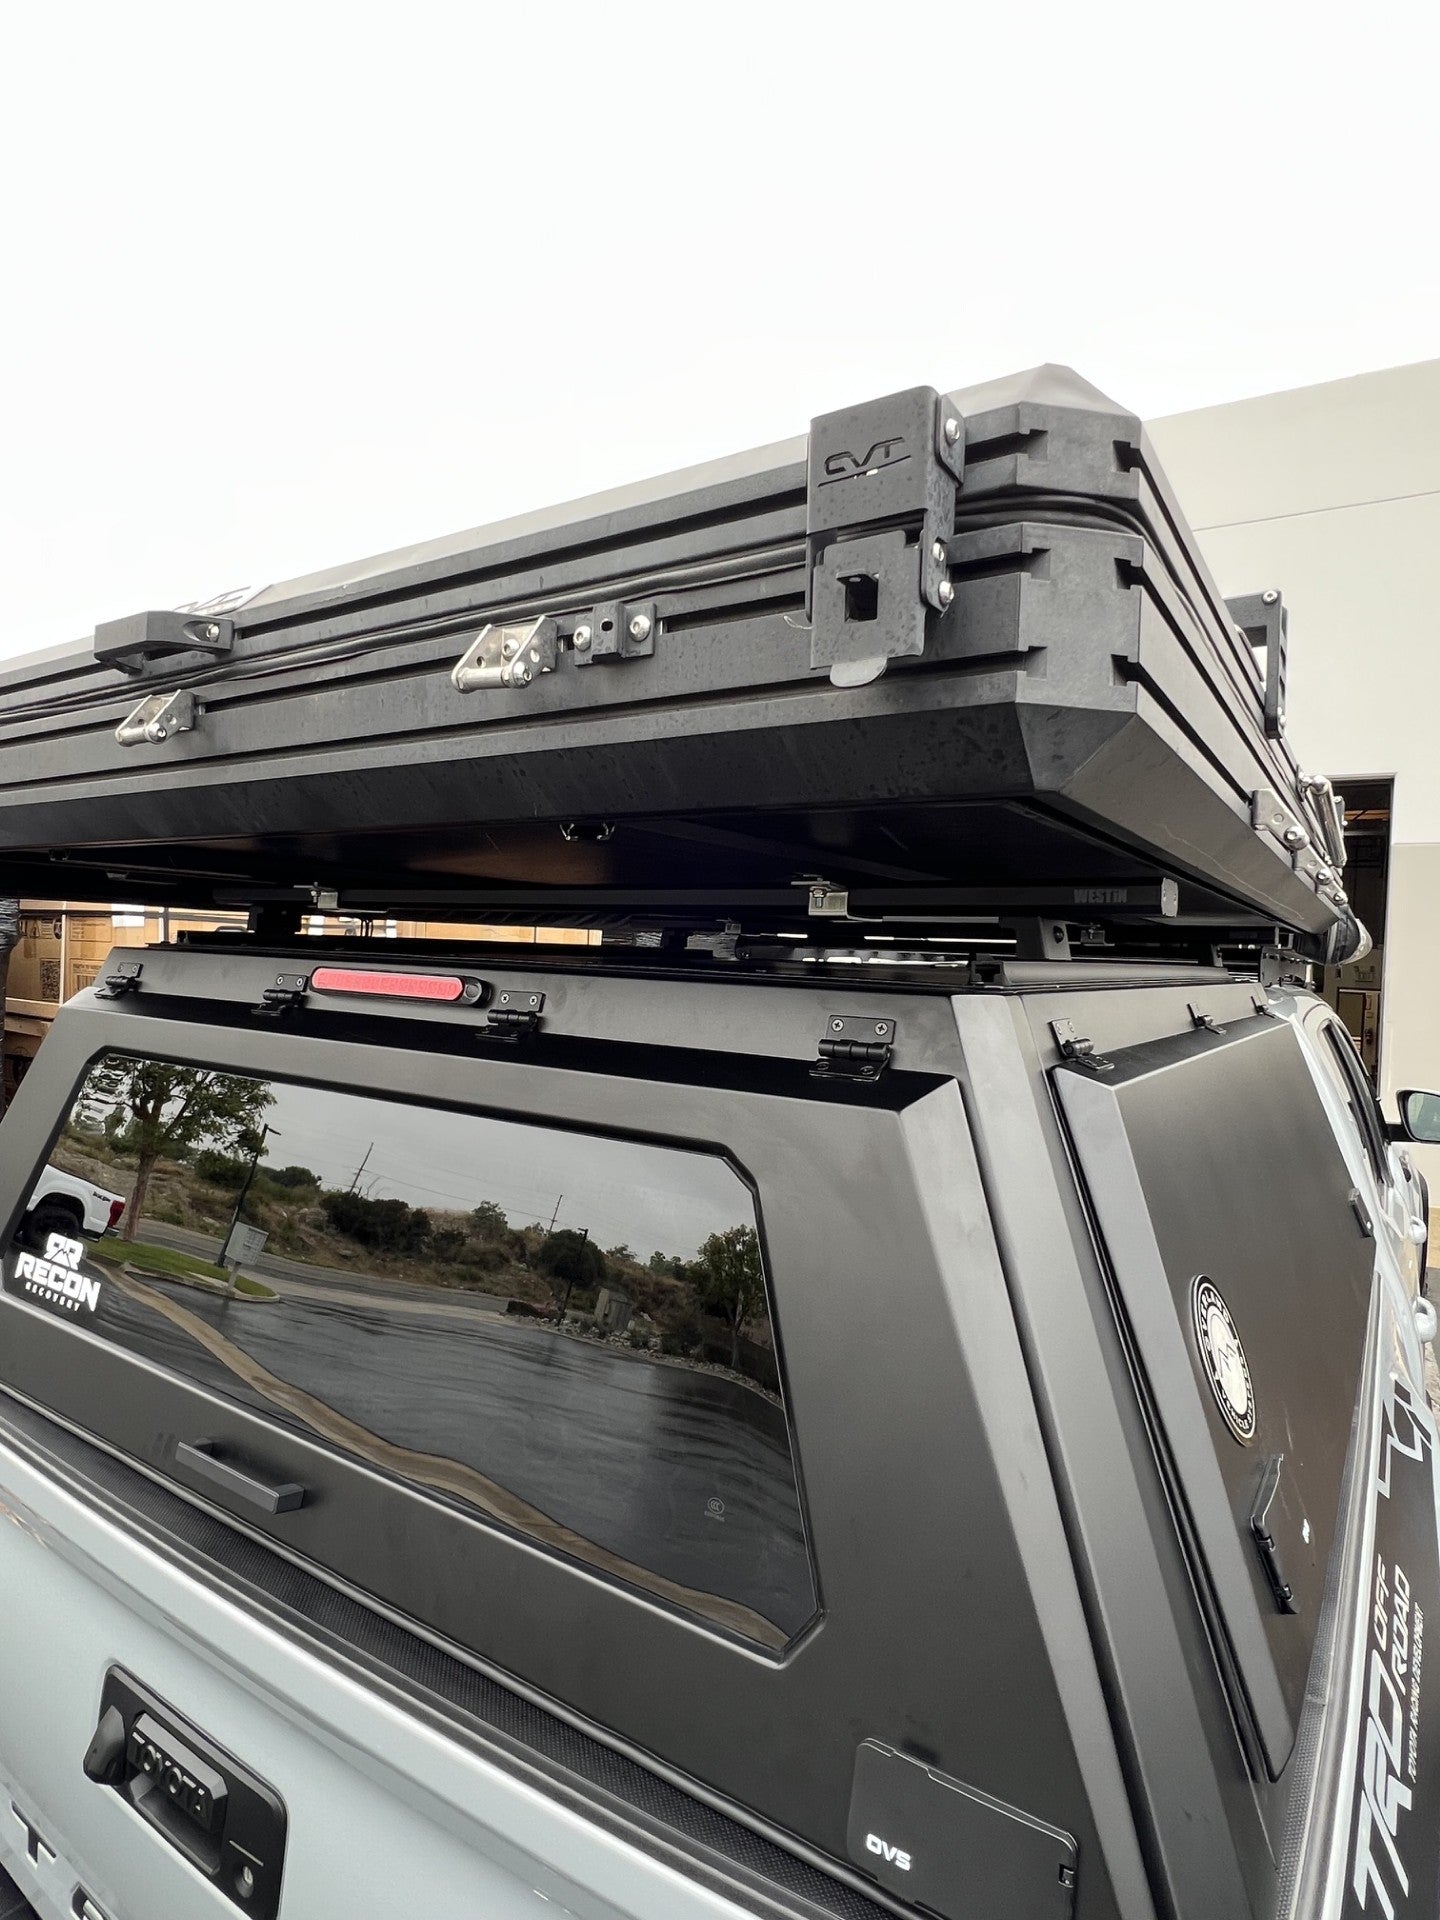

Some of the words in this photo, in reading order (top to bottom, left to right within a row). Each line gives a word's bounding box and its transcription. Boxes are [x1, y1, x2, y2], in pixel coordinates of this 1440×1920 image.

[824, 437, 905, 475] CVT
[14, 1251, 101, 1312] RECON
[1373, 1553, 1390, 1653] OFF
[1391, 1564, 1410, 1696] ROAD
[131, 1731, 211, 1818] TOYOTA
[1353, 1648, 1413, 1920] TRD
[865, 1833, 912, 1871] OVS
